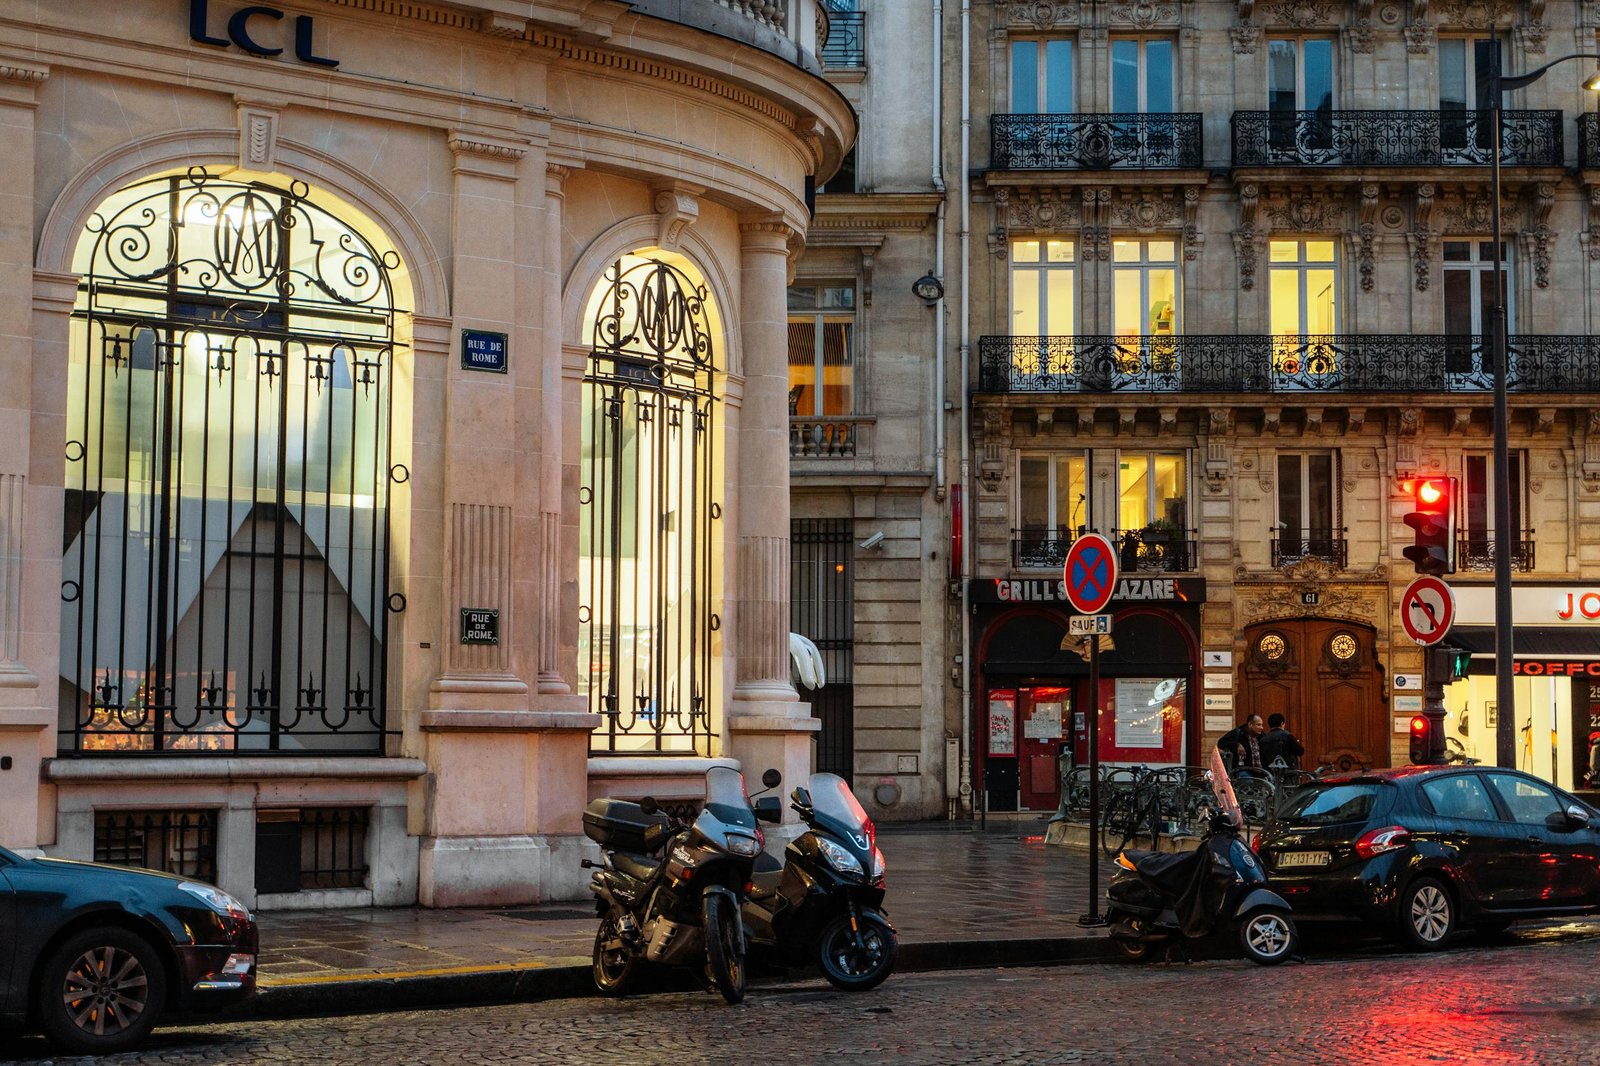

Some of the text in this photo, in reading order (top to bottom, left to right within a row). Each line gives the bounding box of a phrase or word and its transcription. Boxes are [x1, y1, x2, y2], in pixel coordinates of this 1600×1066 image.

[190, 0, 339, 67] LCL
[467, 339, 502, 351] RUE DE
[471, 352, 498, 363] ROME
[997, 580, 1053, 600] GRILL
[1305, 593, 1316, 603] 61
[1558, 592, 1600, 619] JO
[471, 614, 490, 623] RUE
[1071, 619, 1095, 631] SAUF
[468, 630, 493, 639] ROME
